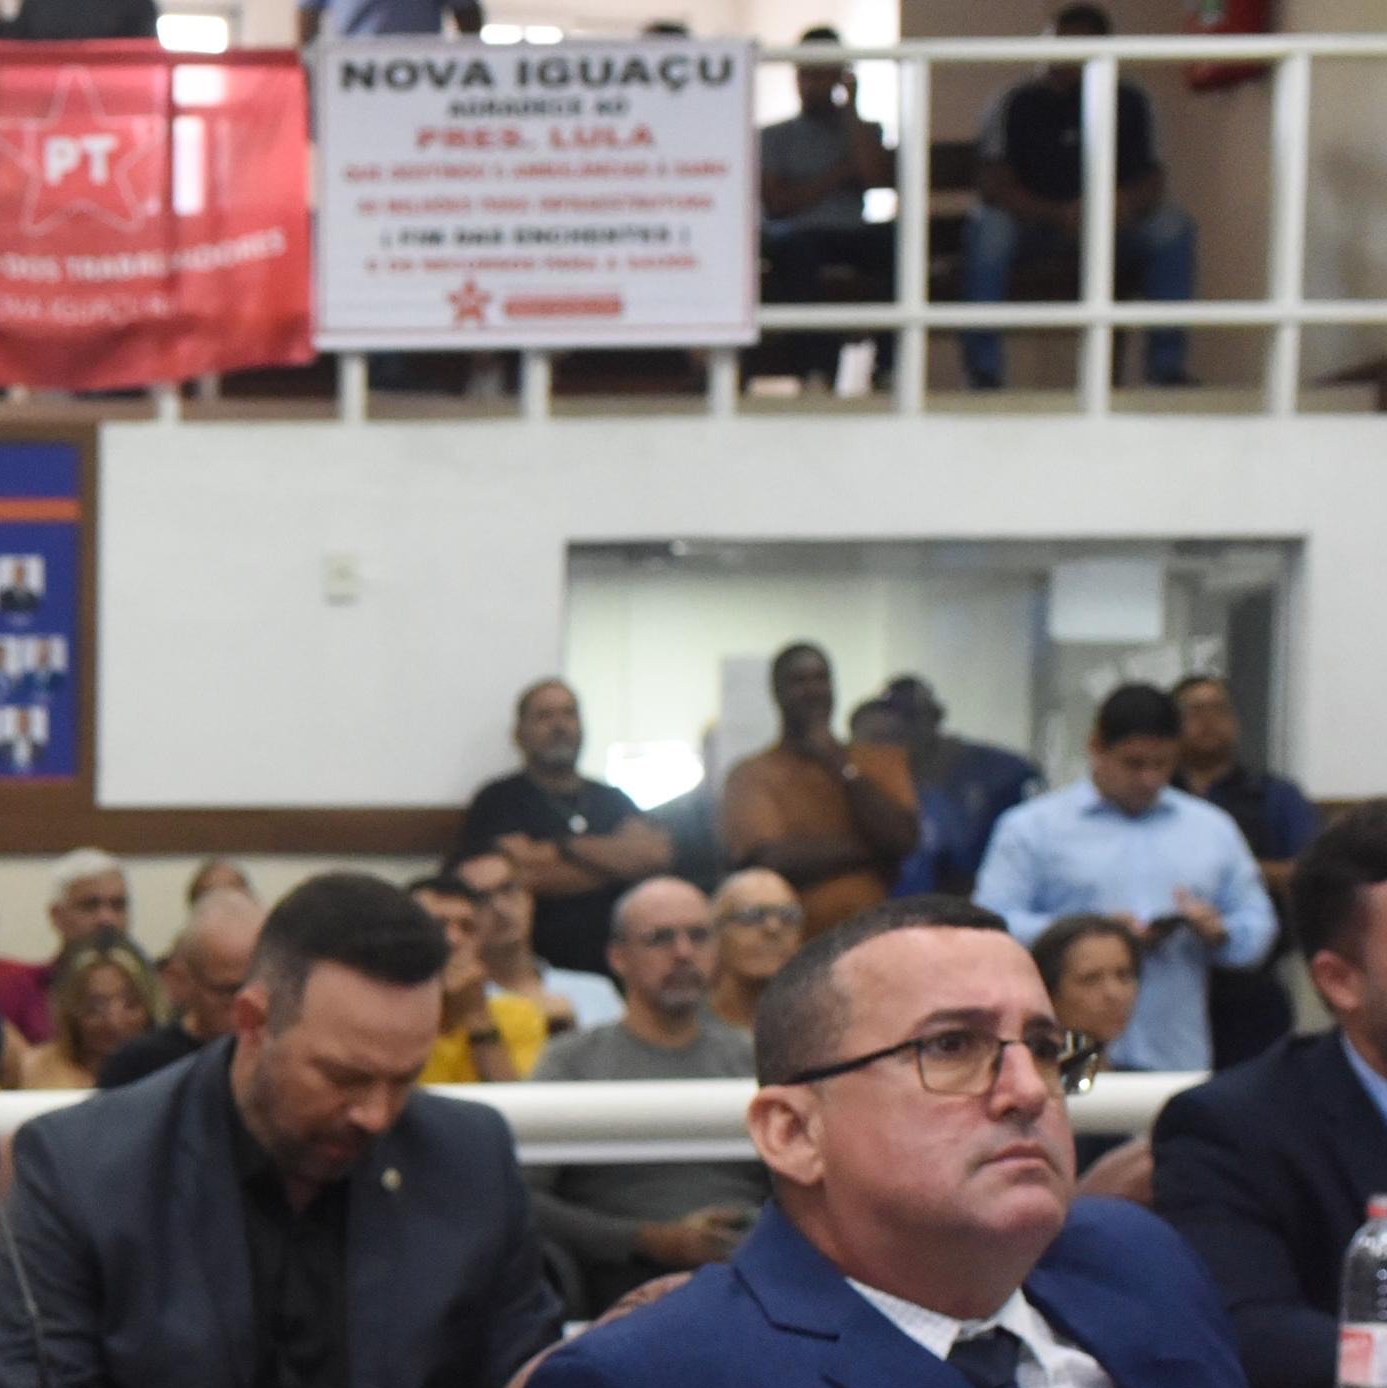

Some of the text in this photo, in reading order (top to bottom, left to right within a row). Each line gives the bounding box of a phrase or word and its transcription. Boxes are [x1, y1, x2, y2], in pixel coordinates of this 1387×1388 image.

[340, 53, 734, 92] NOVA IGUAÇU
[415, 124, 655, 151] PRES. LULA
[43, 134, 117, 184] PT
